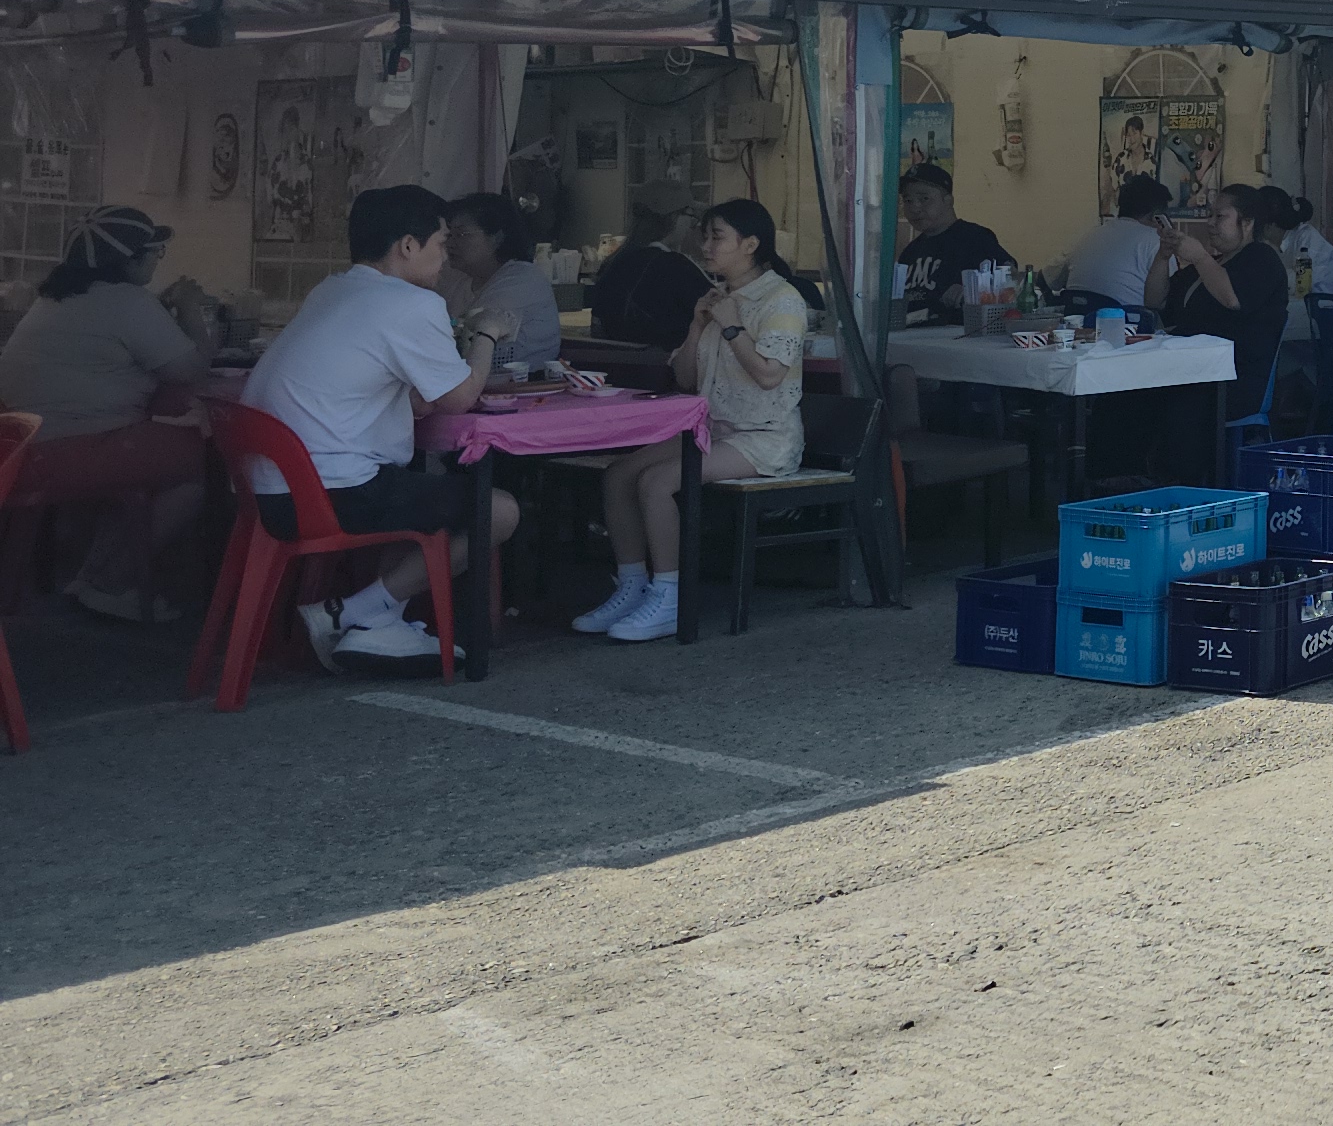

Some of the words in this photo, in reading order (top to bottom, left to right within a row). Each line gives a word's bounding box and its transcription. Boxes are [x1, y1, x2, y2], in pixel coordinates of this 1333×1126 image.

[1270, 505, 1303, 534] Cass
[1093, 554, 1132, 571] 하이트진로
[1197, 543, 1246, 566] 하이트진로
[984, 624, 1020, 644] (주)두산
[1078, 649, 1104, 663] JINRO
[1105, 651, 1128, 666] SOJU
[1198, 638, 1234, 661] 카스
